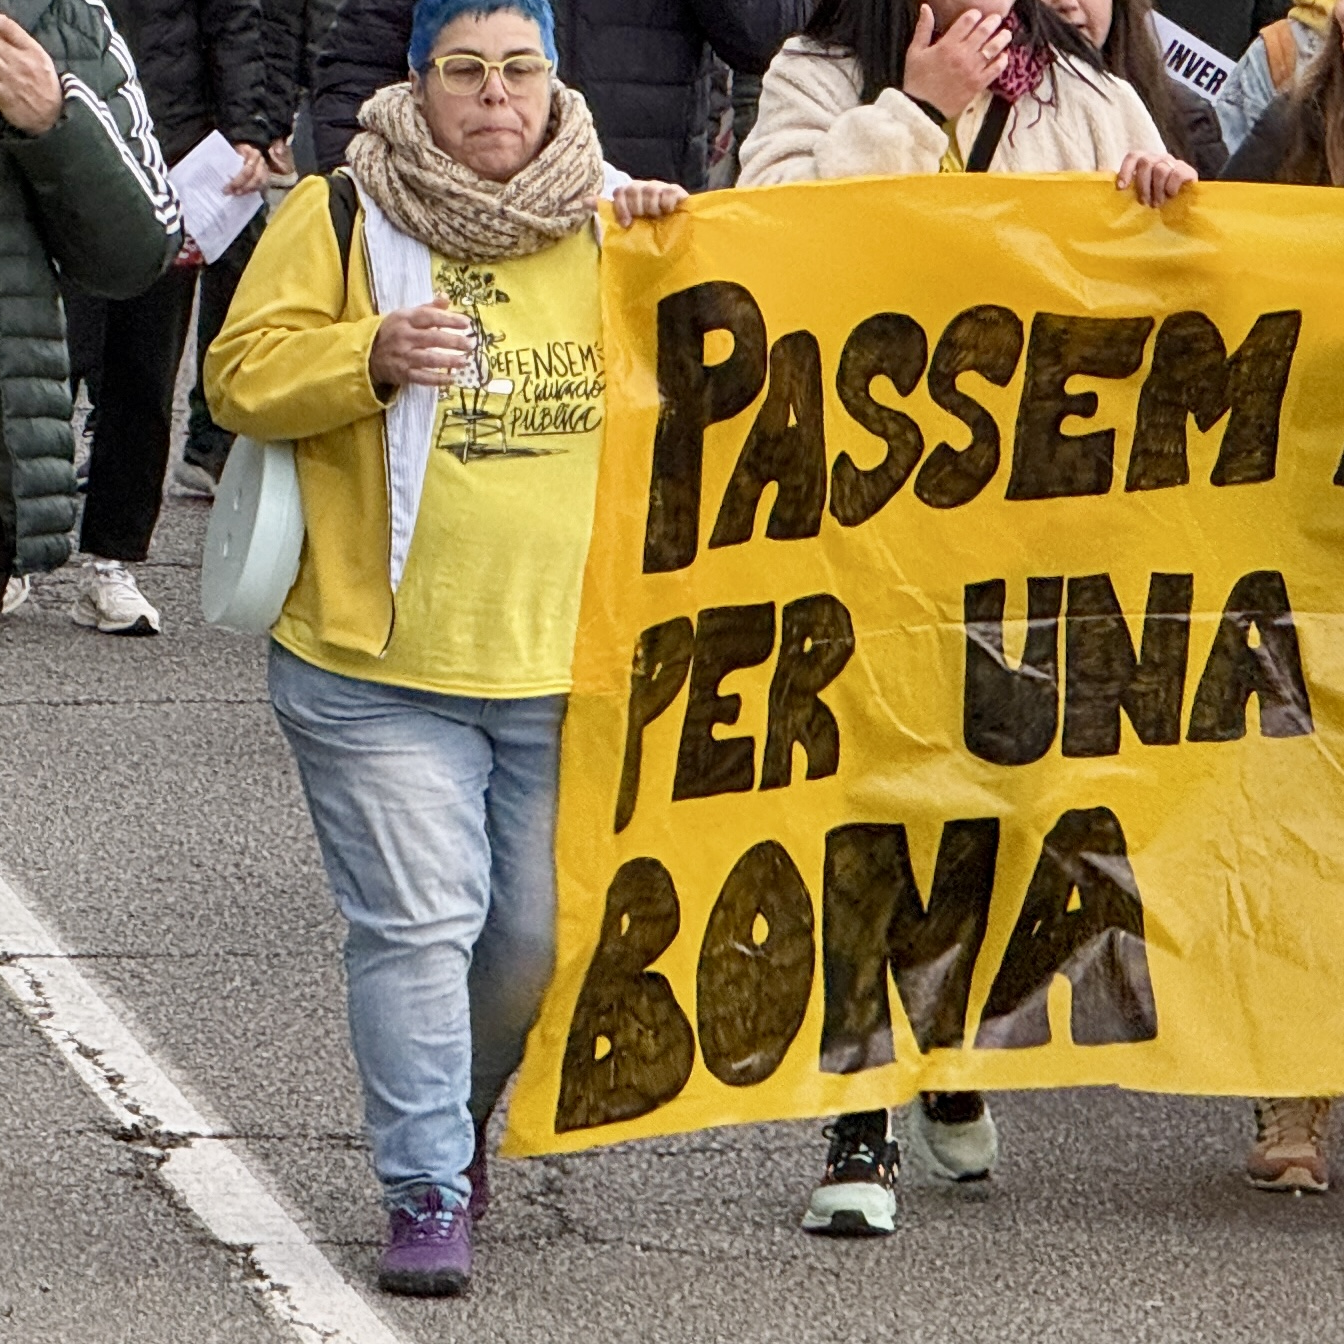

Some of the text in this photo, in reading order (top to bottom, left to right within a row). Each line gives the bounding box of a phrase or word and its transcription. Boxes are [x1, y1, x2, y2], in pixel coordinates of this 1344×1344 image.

[1163, 39, 1229, 96] INVER
[490, 341, 598, 380] DEFENSEM
[643, 280, 1302, 575] PASSEM
[614, 569, 1314, 835] PER UNA
[555, 806, 1158, 1134] BONA
